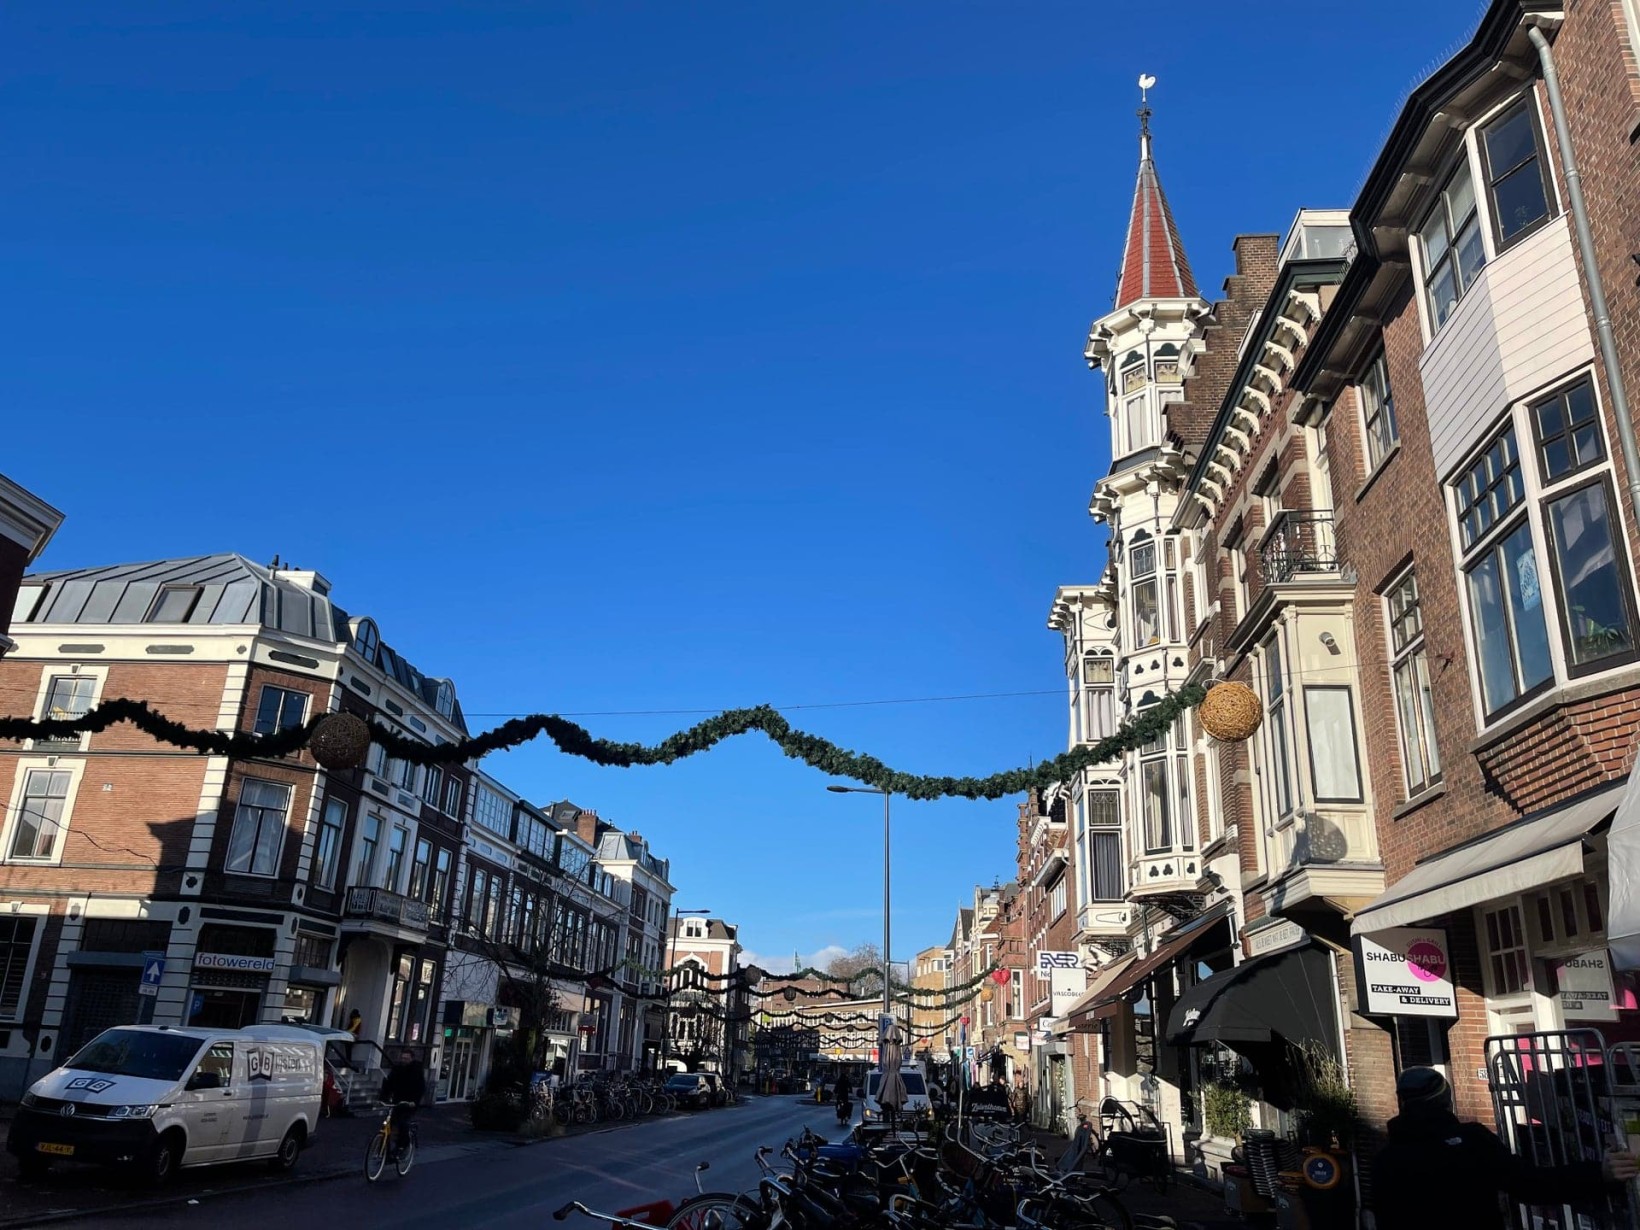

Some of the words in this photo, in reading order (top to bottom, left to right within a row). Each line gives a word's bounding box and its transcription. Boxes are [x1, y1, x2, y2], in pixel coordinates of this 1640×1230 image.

[198, 953, 276, 971] fotowereld
[1366, 952, 1405, 963] SHABU
[1406, 952, 1445, 965] SHABU
[1371, 985, 1419, 994] TAKE-AWAY
[1410, 996, 1450, 1005] DELIVERY
